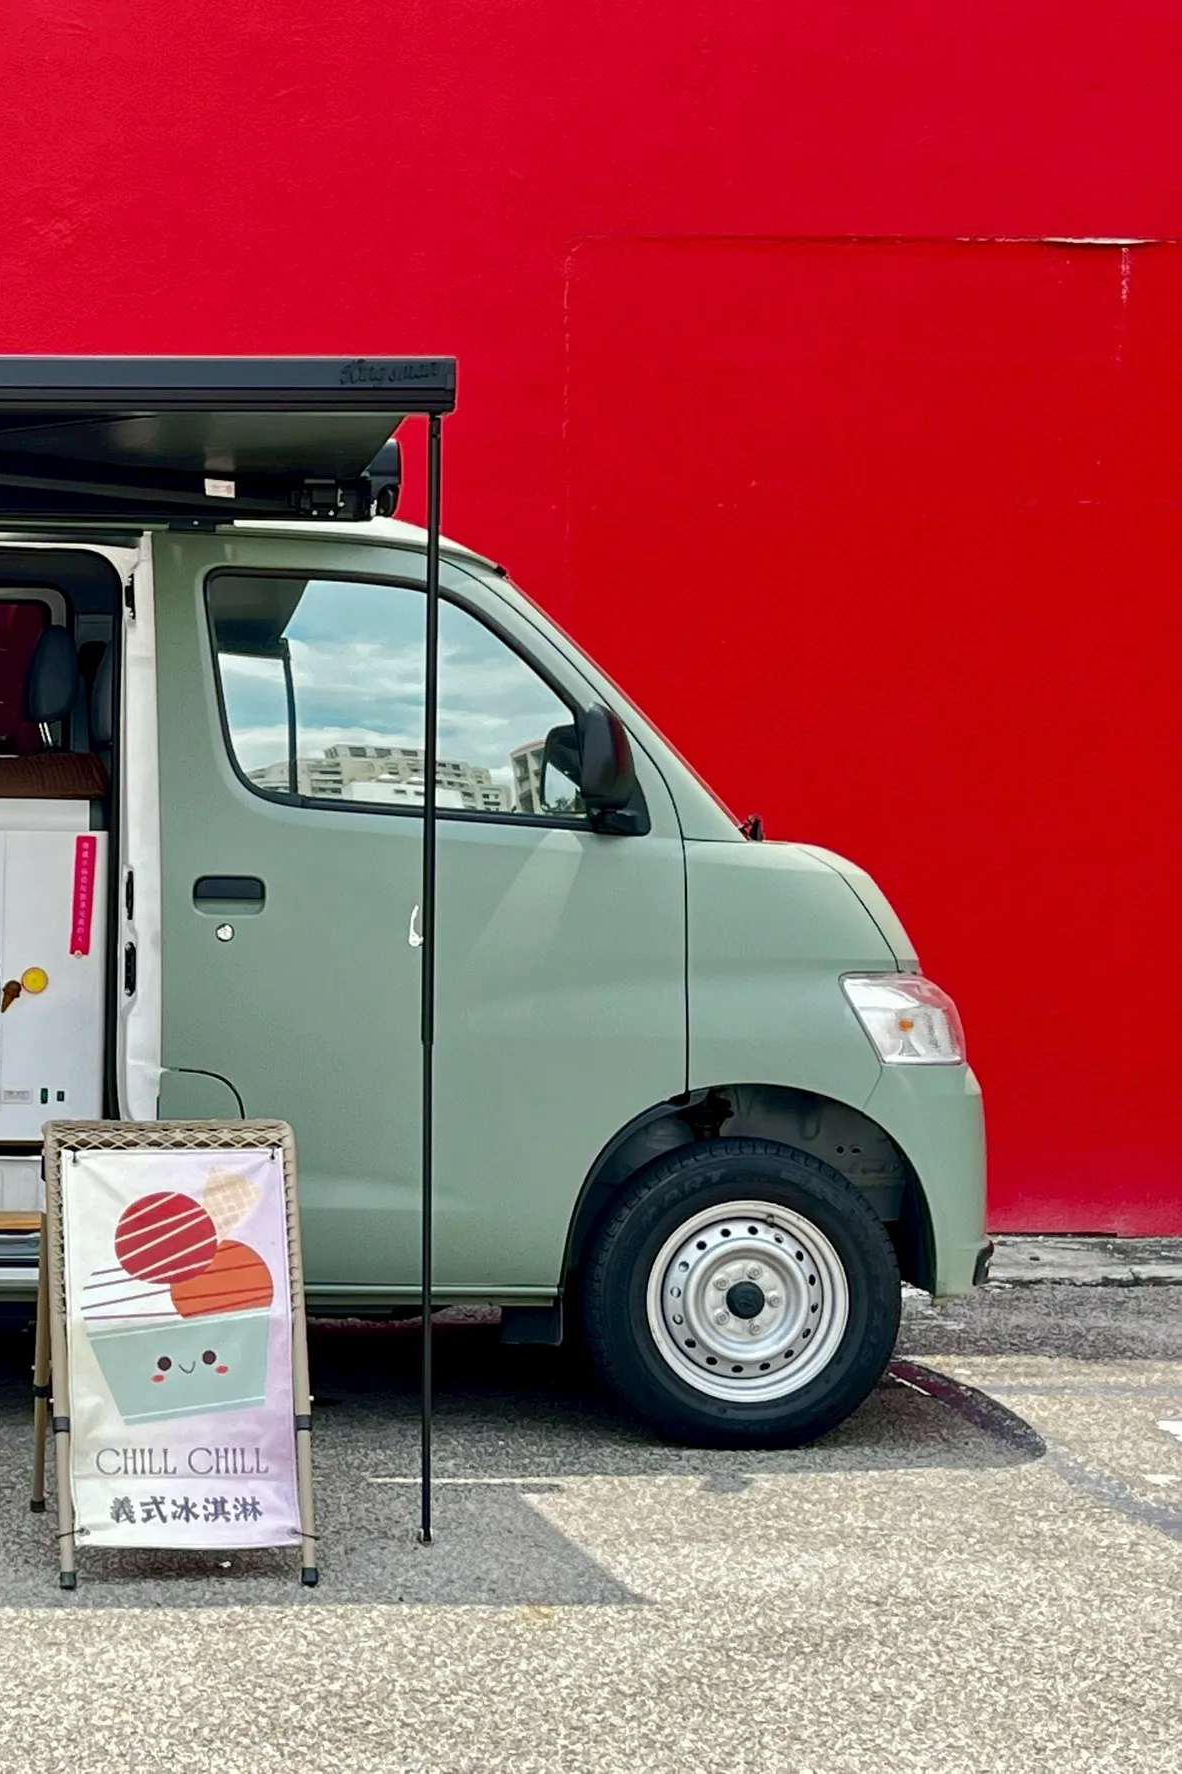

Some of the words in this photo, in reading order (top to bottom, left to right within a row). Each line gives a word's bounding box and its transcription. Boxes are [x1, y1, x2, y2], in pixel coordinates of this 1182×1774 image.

[96, 1447, 177, 1476] CHILL
[187, 1447, 269, 1476] CHILL
[109, 1495, 264, 1524] 義式冰淇淋
